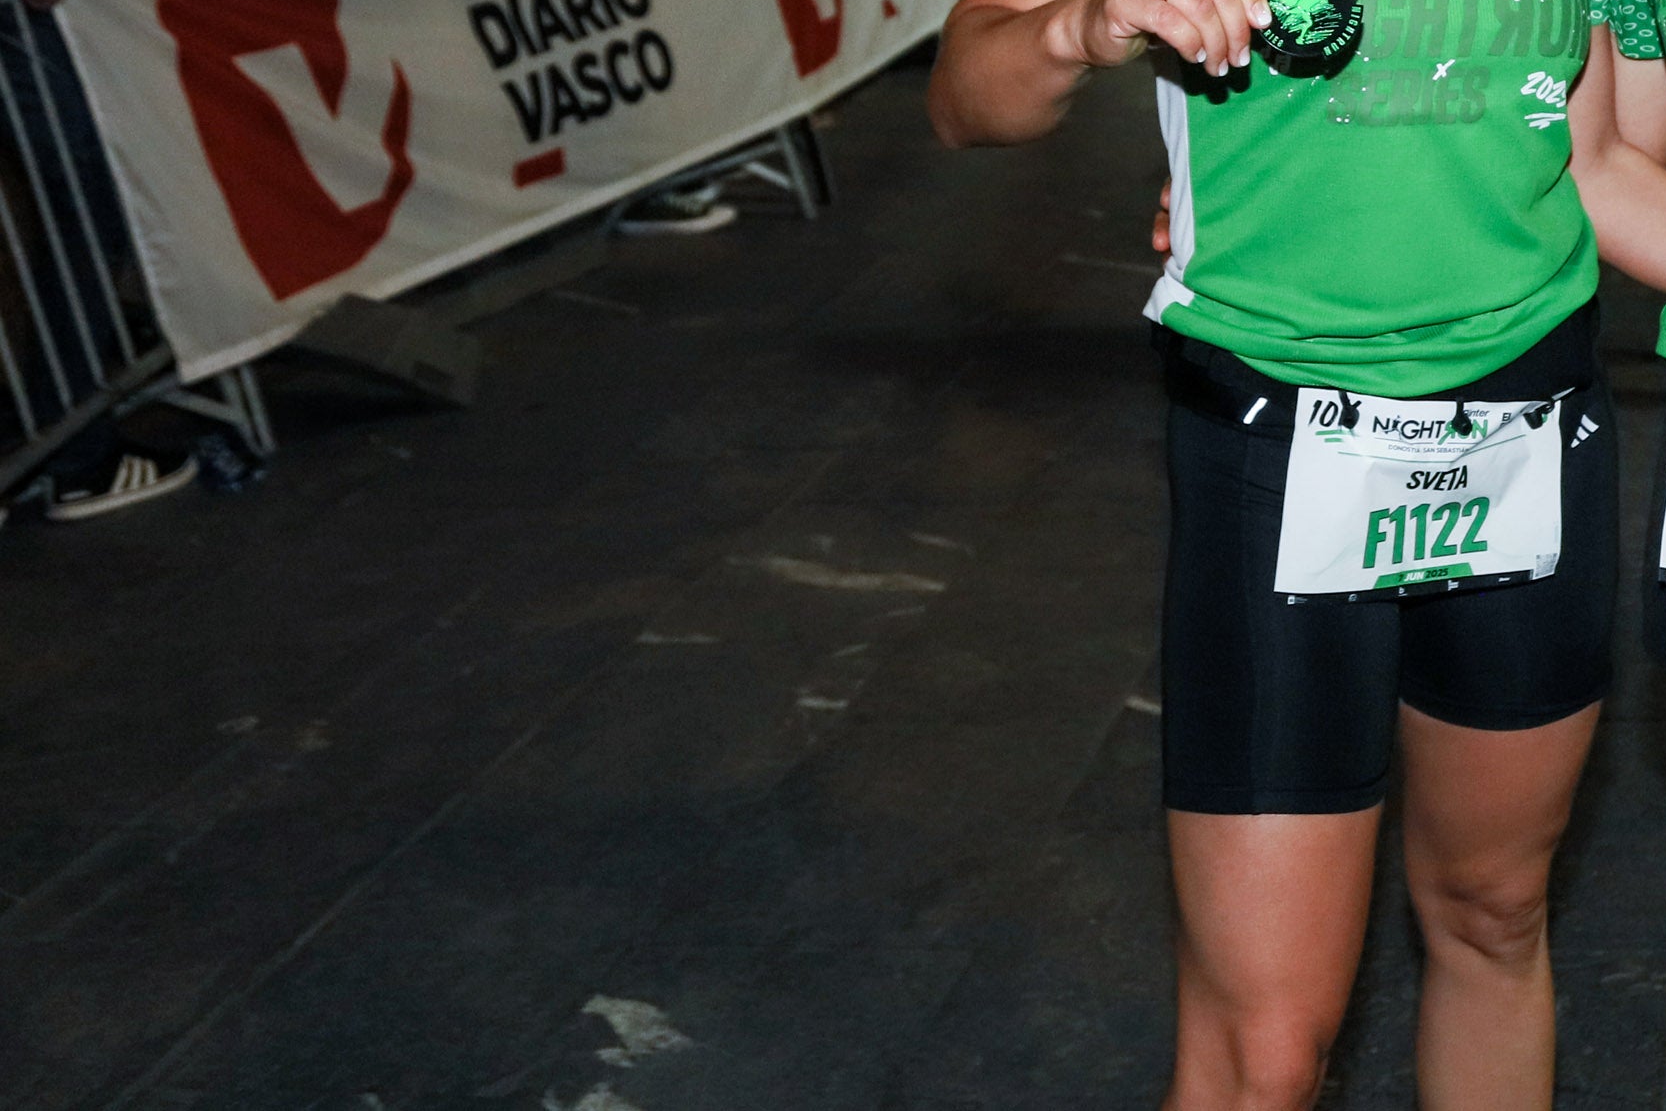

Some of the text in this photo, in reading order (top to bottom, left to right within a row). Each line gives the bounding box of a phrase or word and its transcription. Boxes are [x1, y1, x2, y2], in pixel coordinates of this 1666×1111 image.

[1322, 5, 1362, 57] NIGHTRUN
[502, 29, 676, 145] VASCO
[1406, 465, 1468, 491] SVETA
[1362, 496, 1490, 569] F1122
[1404, 570, 1425, 582] JUN
[1425, 567, 1449, 579] 2025
